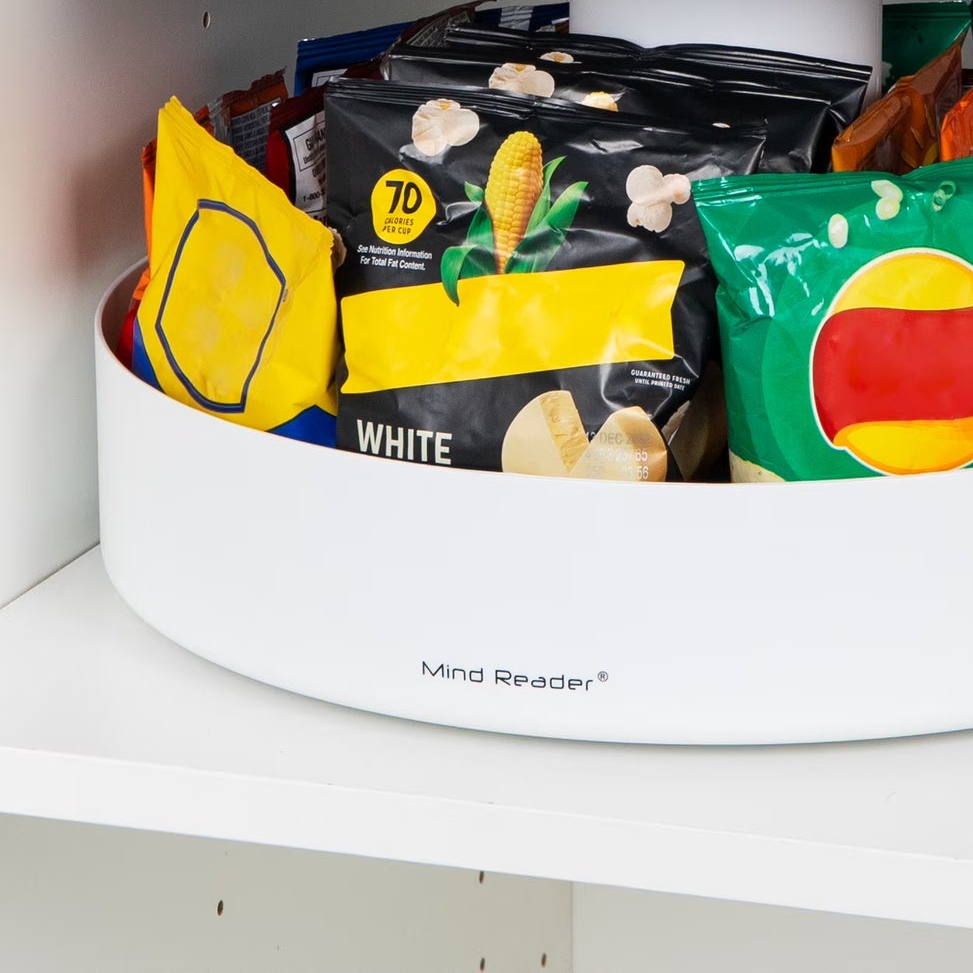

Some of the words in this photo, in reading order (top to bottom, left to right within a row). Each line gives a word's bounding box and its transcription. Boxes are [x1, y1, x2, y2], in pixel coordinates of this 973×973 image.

[385, 180, 423, 215] 70
[384, 217, 415, 226] CALORIES
[382, 225, 396, 234] PER
[397, 226, 412, 235] CUP
[357, 244, 368, 254] See
[368, 246, 397, 257] Nutrition
[397, 248, 433, 260] Information
[360, 256, 371, 265] For
[371, 257, 387, 267] Total
[388, 259, 398, 268] Fat
[399, 260, 426, 271] Content.
[630, 369, 671, 381] GUARANTEED
[672, 375, 691, 385] FRESH
[634, 378, 650, 386] UNTIL
[651, 380, 673, 389] PRINTED
[673, 382, 685, 391] DATE
[356, 419, 453, 465] WHITE
[422, 660, 484, 683] Mind
